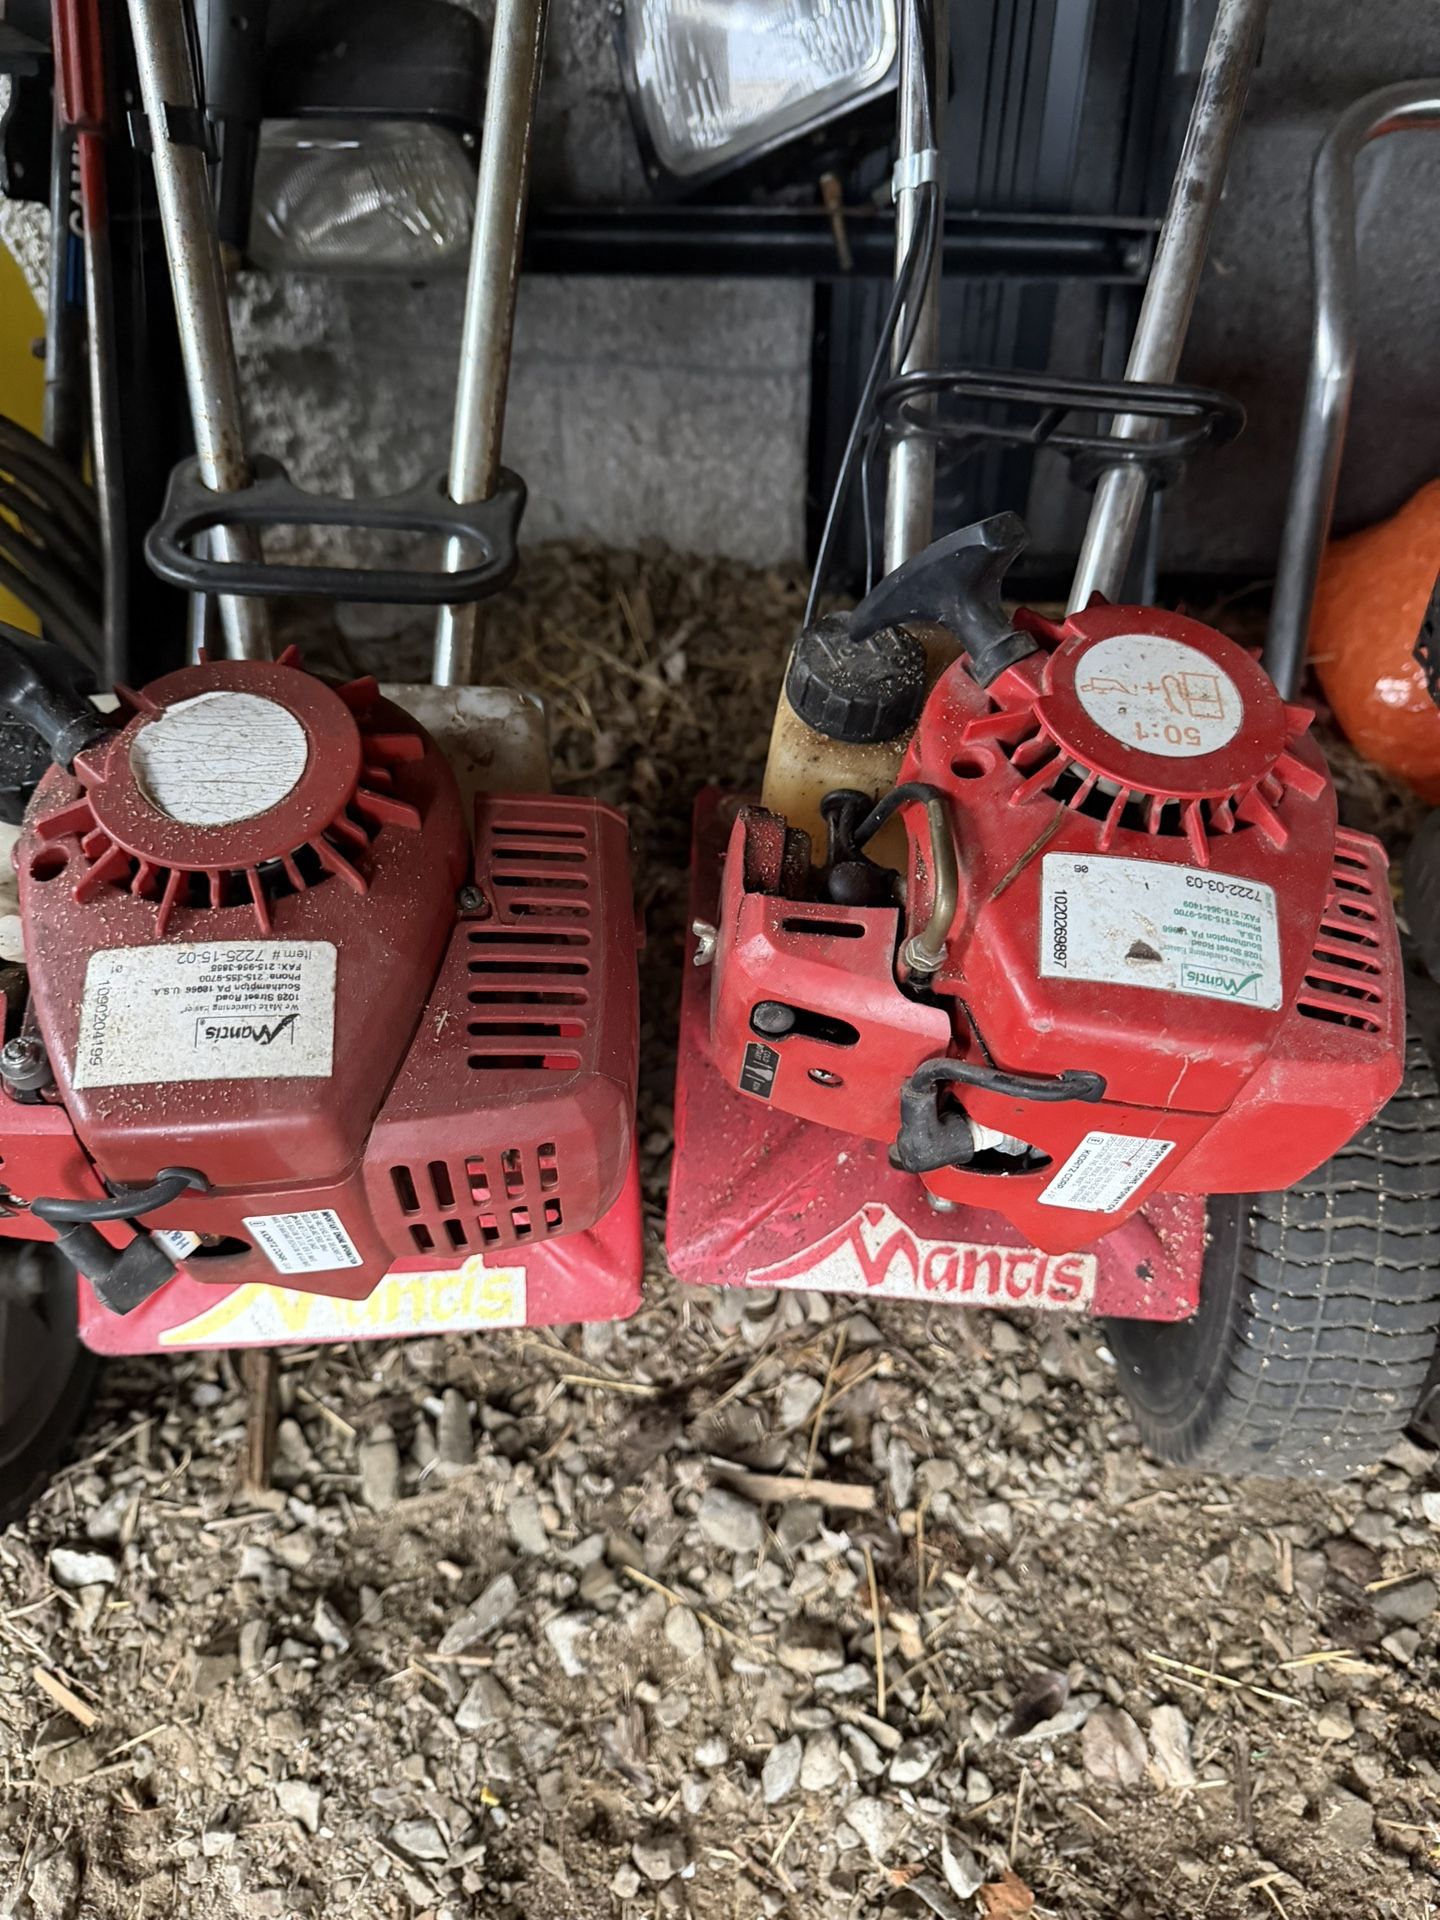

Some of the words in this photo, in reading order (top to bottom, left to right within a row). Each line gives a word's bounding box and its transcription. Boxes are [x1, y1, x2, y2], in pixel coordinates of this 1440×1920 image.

[1135, 721, 1201, 746] 50:1
[1185, 875, 1262, 903] 7222-03-03
[1183, 900, 1239, 917] 215-364-1409
[1173, 908, 1231, 925] 215-355-9700
[1240, 911, 1261, 923] FAX:
[1053, 889, 1068, 969] 1020269897
[1233, 919, 1262, 932] Phone:
[1191, 930, 1204, 939] PA
[1191, 940, 1215, 950] Road
[1206, 932, 1263, 951] Southampton
[284, 949, 313, 960] Item
[1216, 945, 1242, 956] Street
[1244, 950, 1263, 961] 1028
[176, 949, 264, 965] 7225-15-02
[278, 963, 302, 971] FAX:
[234, 983, 301, 991] Southampton
[1186, 970, 1264, 996] Mantis
[151, 986, 181, 996] U.S.A.
[247, 993, 275, 1001] Street
[277, 993, 300, 1001] 1028
[215, 994, 244, 1002] Road
[89, 979, 110, 1067] 1090204199
[205, 1013, 300, 1046] Mantis
[746, 1203, 1084, 1300] Mantis
